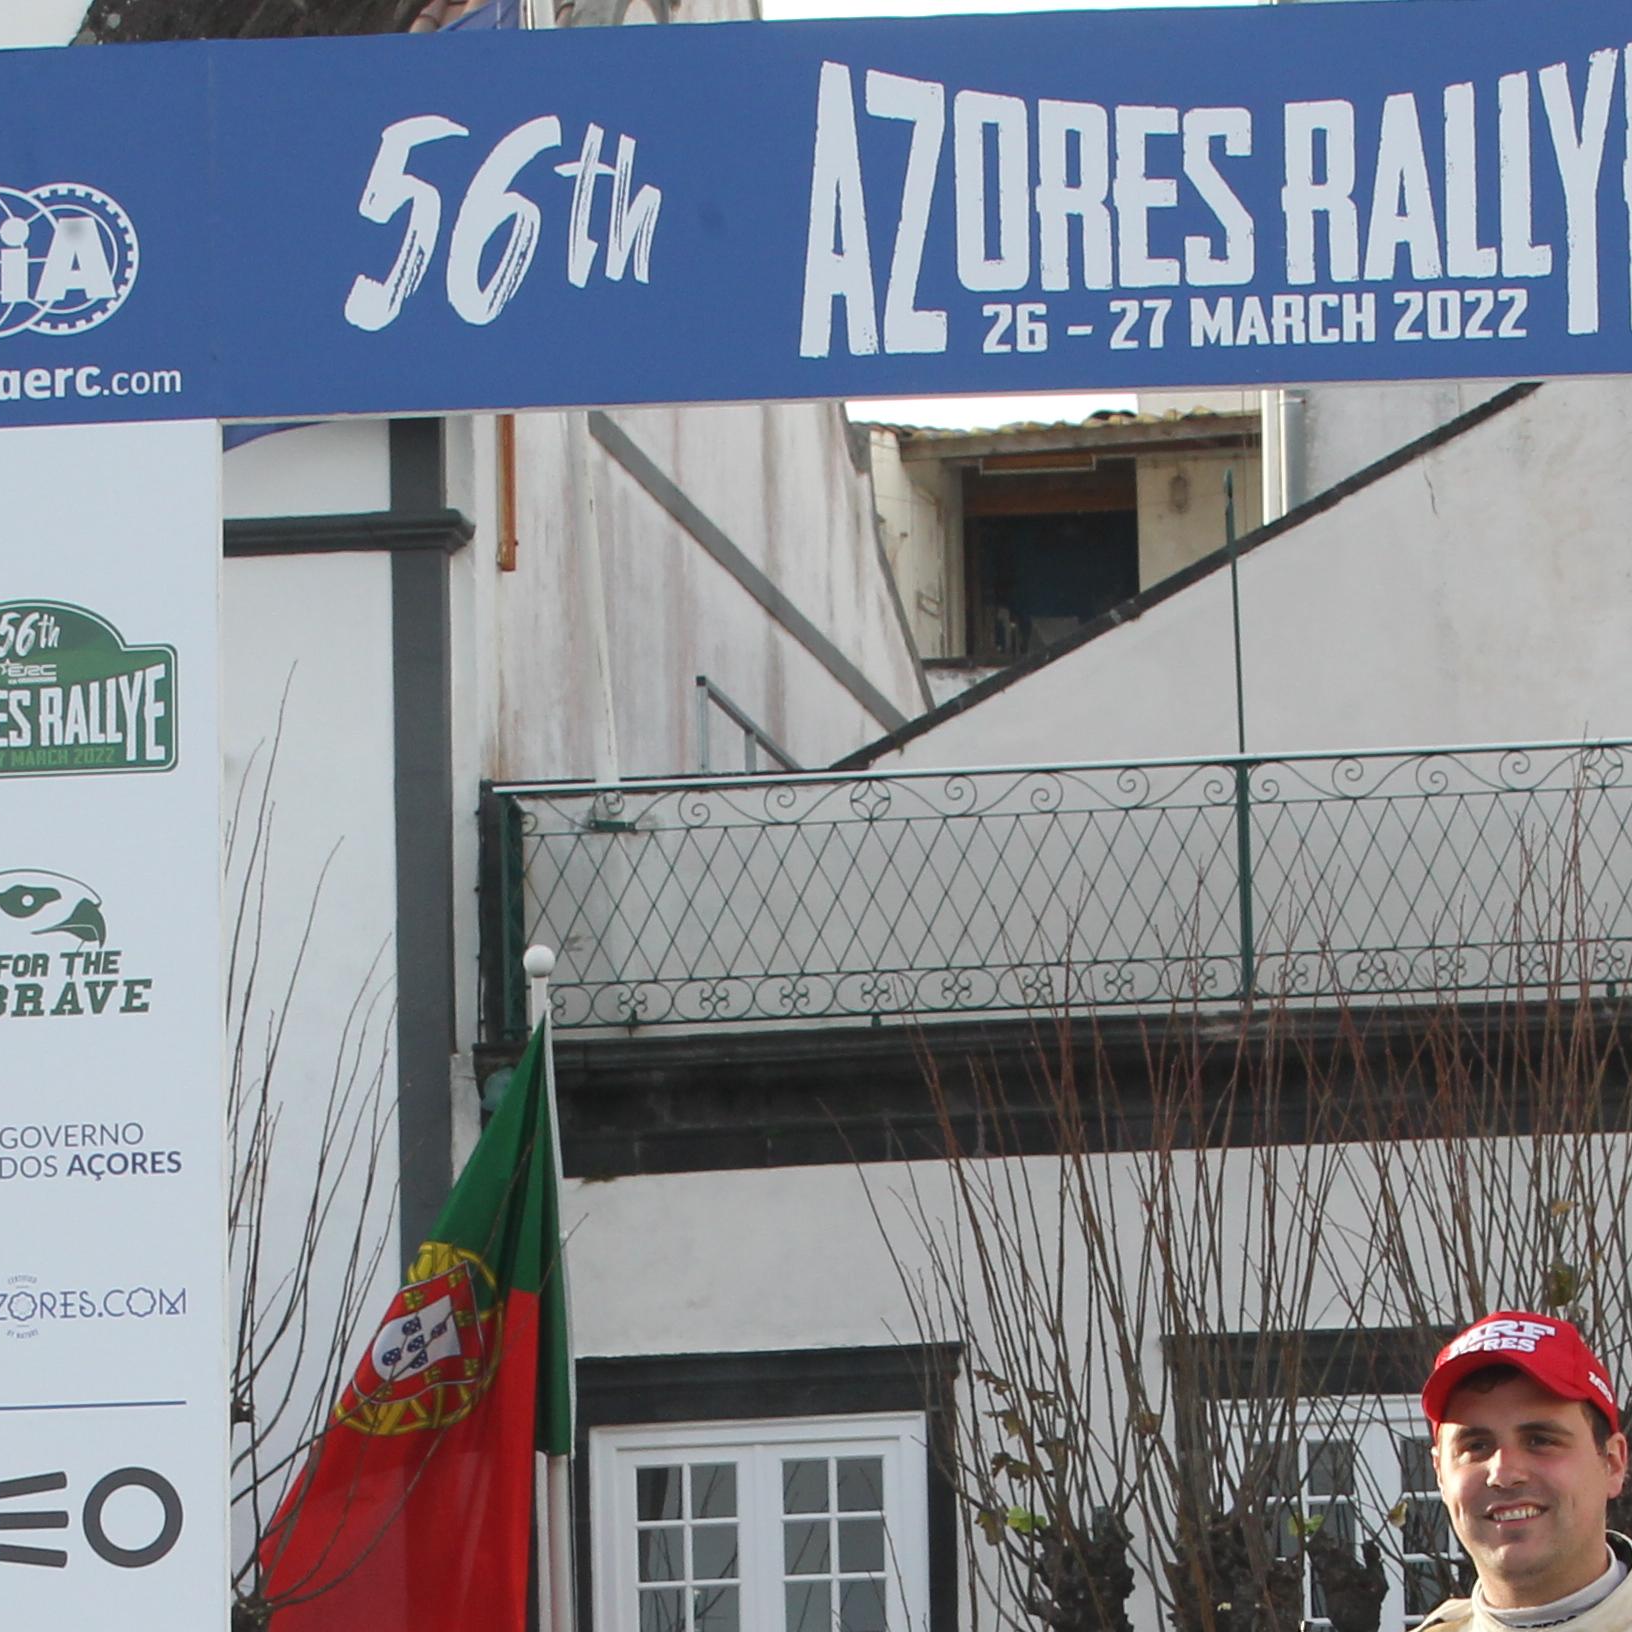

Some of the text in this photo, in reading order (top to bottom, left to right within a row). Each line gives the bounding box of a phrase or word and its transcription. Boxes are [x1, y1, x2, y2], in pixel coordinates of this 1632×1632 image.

[344, 115, 662, 331] 56th
[799, 61, 1255, 359] AZORES
[982, 290, 1528, 354] 26 27 MARCH 2022
[40, 663, 165, 761] RALLYE
[59, 950, 121, 980] THE
[66, 1151, 182, 1181] AÇORES
